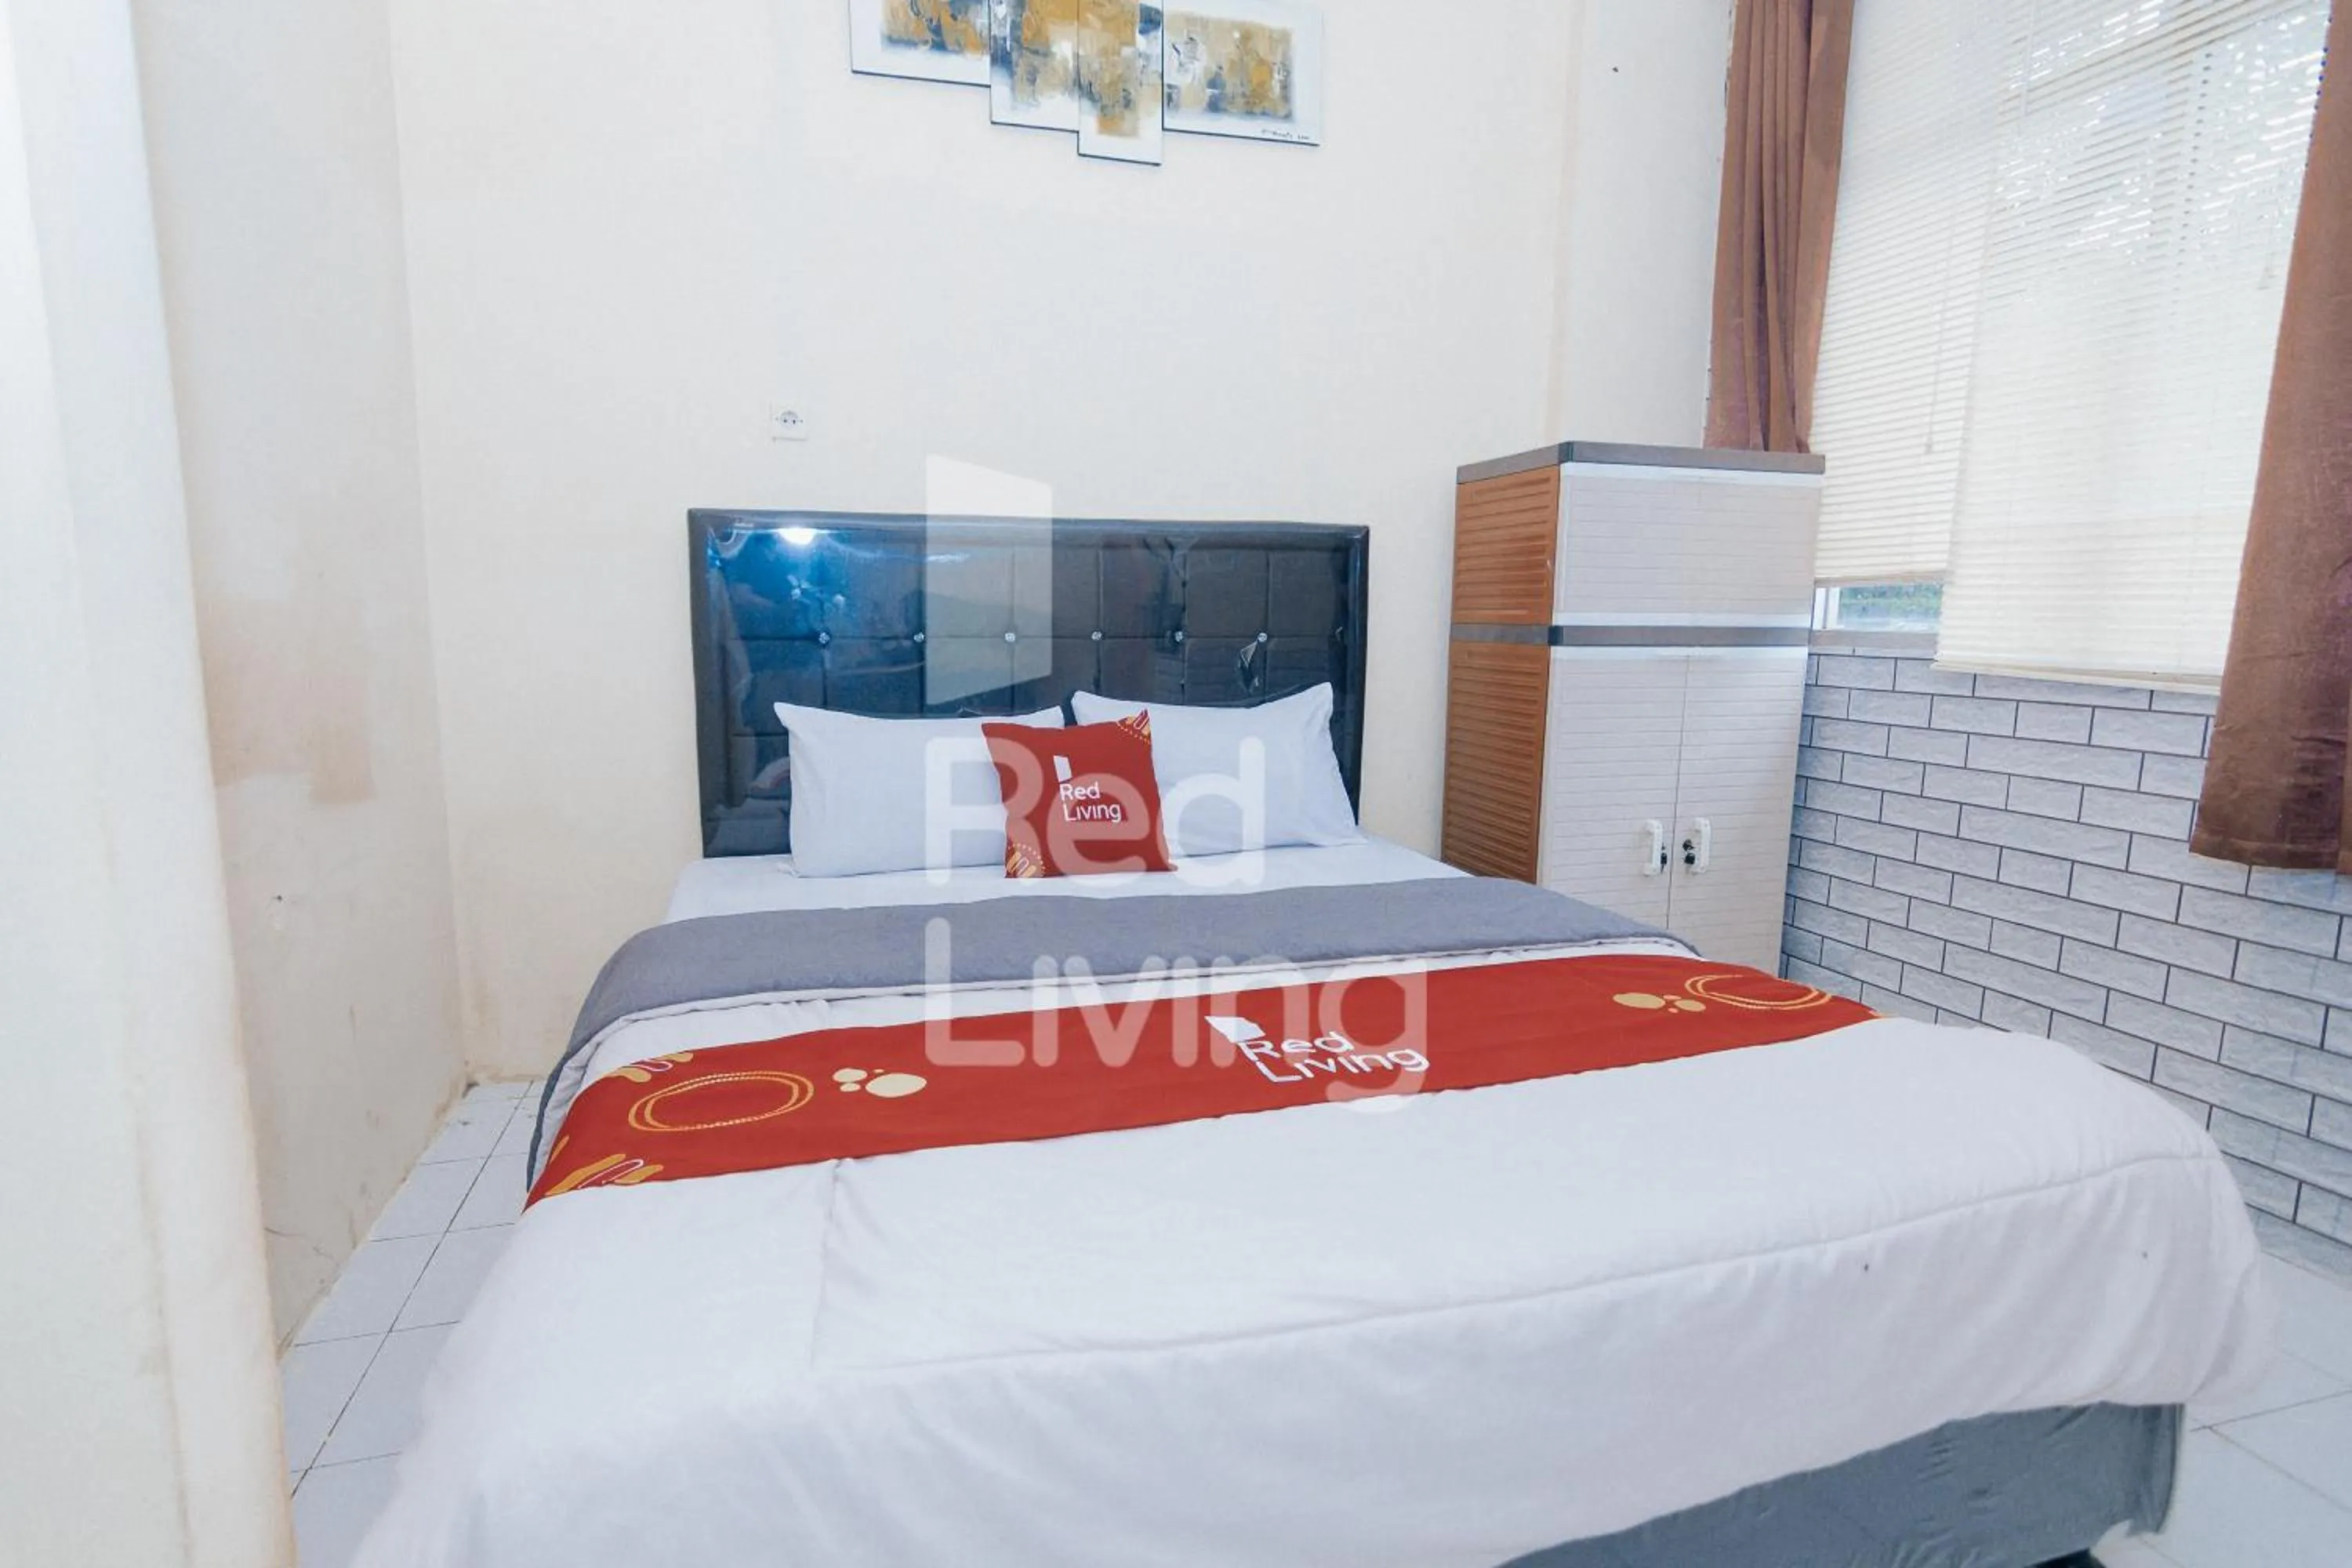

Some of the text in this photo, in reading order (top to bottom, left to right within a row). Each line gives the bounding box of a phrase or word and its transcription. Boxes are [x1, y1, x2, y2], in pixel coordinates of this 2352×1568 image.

[1059, 781, 1100, 801] Red
[1062, 802, 1122, 822] Living
[1236, 1031, 1355, 1062] Red
[1255, 1048, 1430, 1083] Living
